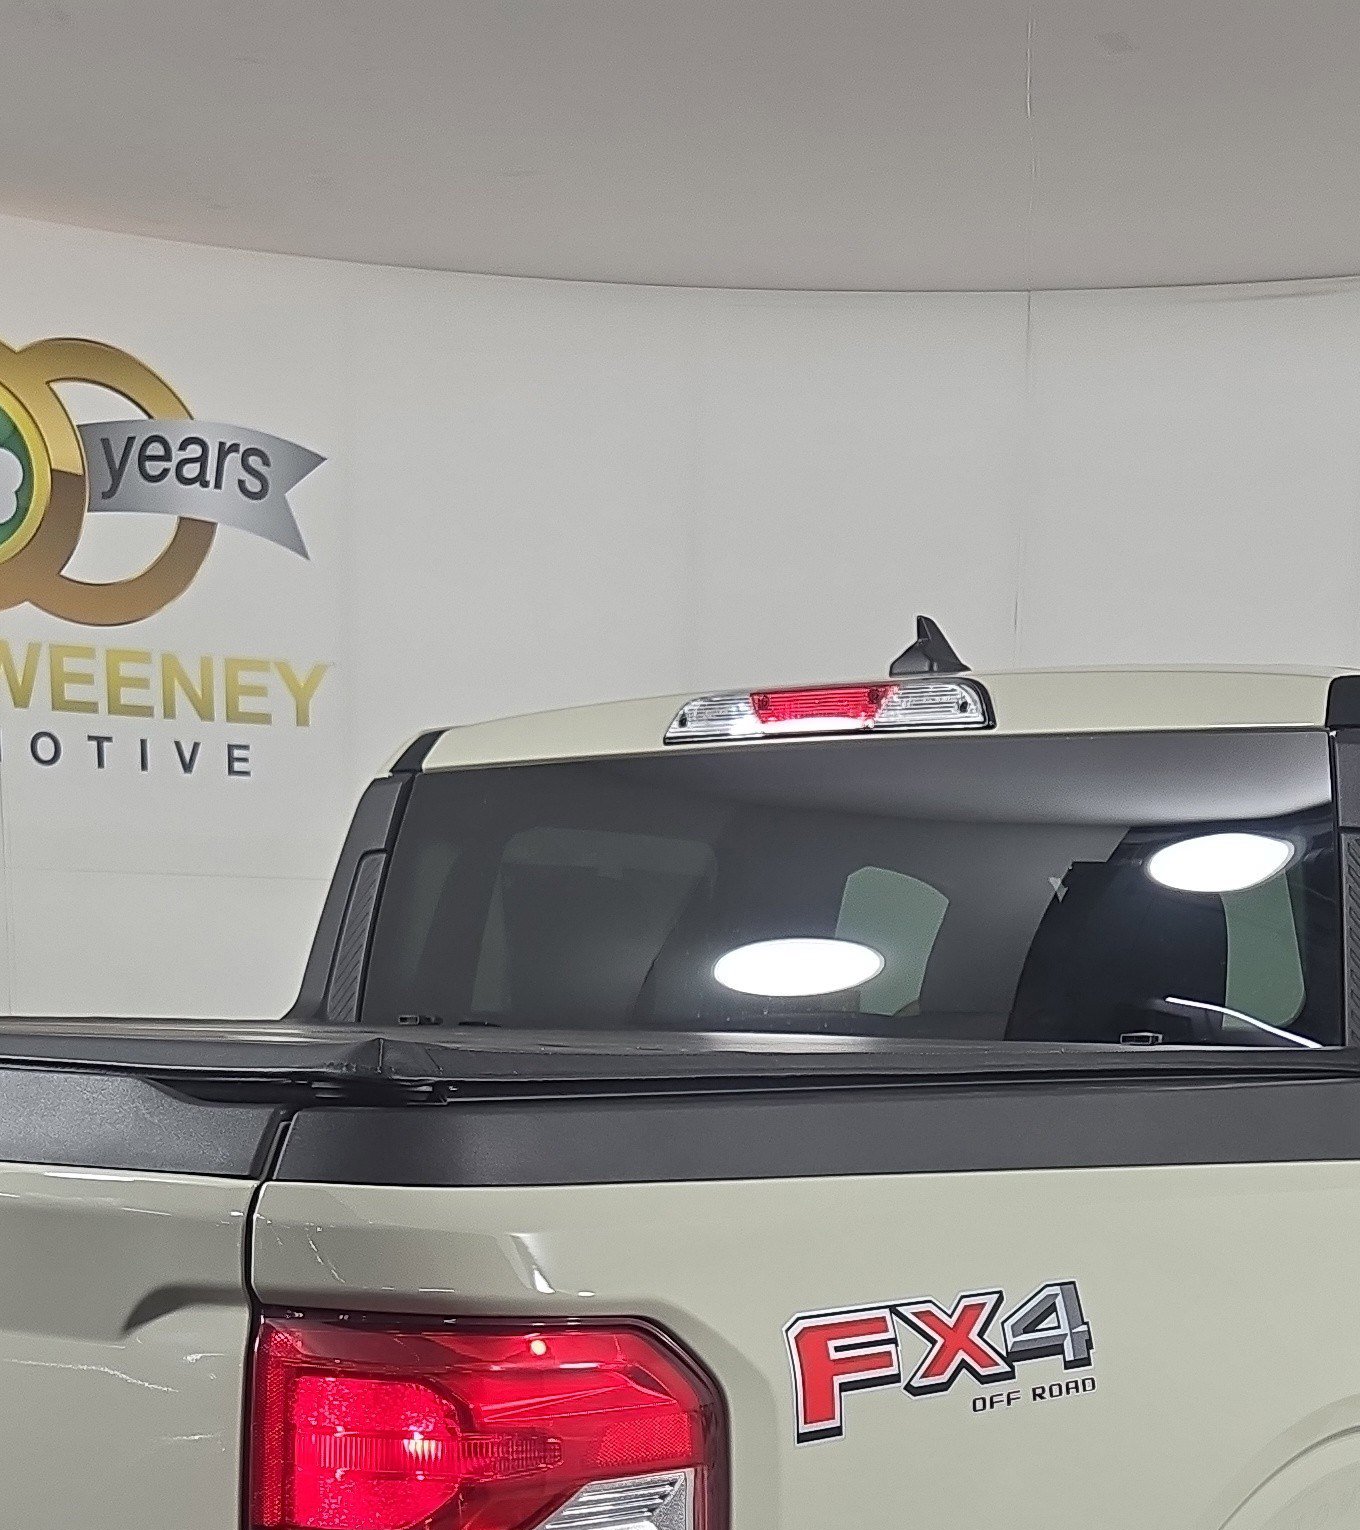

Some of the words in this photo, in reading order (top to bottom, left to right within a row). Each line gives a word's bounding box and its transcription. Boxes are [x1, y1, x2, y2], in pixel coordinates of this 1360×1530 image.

[100, 426, 273, 501] years
[782, 1279, 1095, 1446] FX4
[971, 1389, 1022, 1413] OFF
[1031, 1376, 1097, 1402] ROAD
